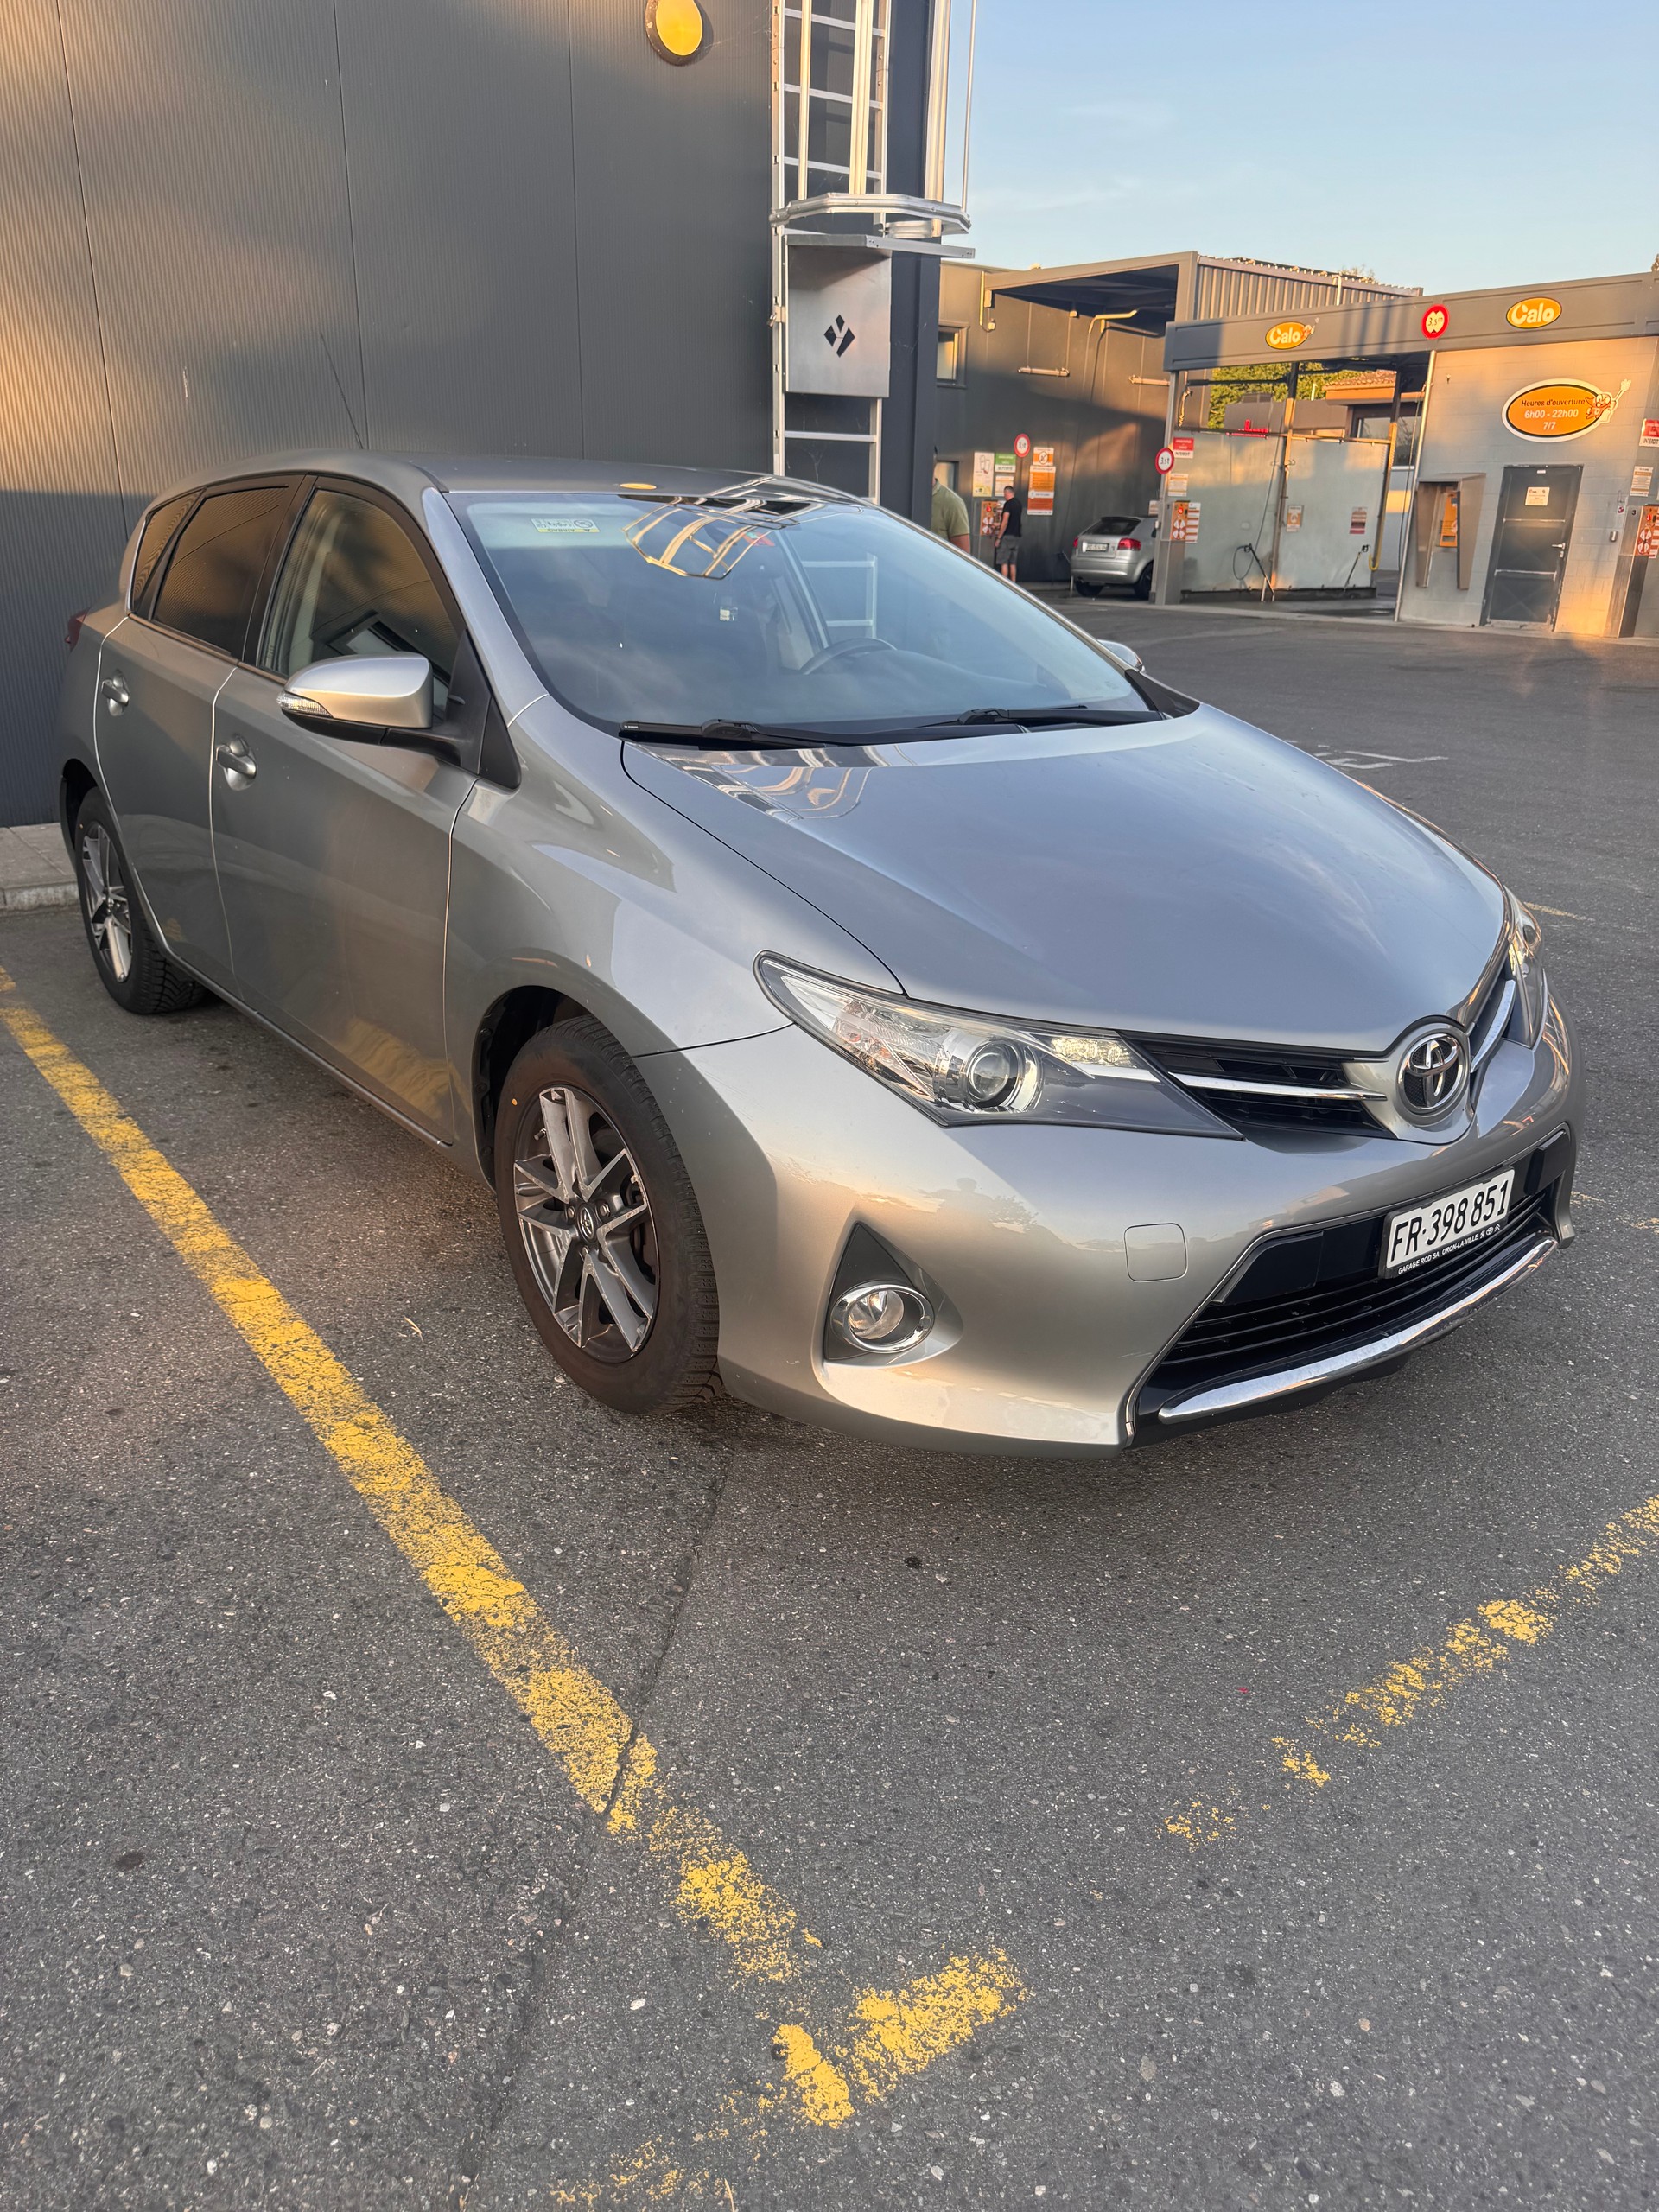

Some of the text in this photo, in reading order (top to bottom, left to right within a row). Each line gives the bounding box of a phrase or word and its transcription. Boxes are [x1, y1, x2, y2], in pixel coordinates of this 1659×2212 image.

[1511, 303, 1554, 325] Calo
[1269, 327, 1300, 345] Calo
[1524, 410, 1546, 419] 6h00
[1552, 409, 1579, 418] 22h00
[1543, 421, 1557, 430] 7/7
[1398, 1234, 1478, 1274] GARAGE ROD SA ORON-LA-VILLE
